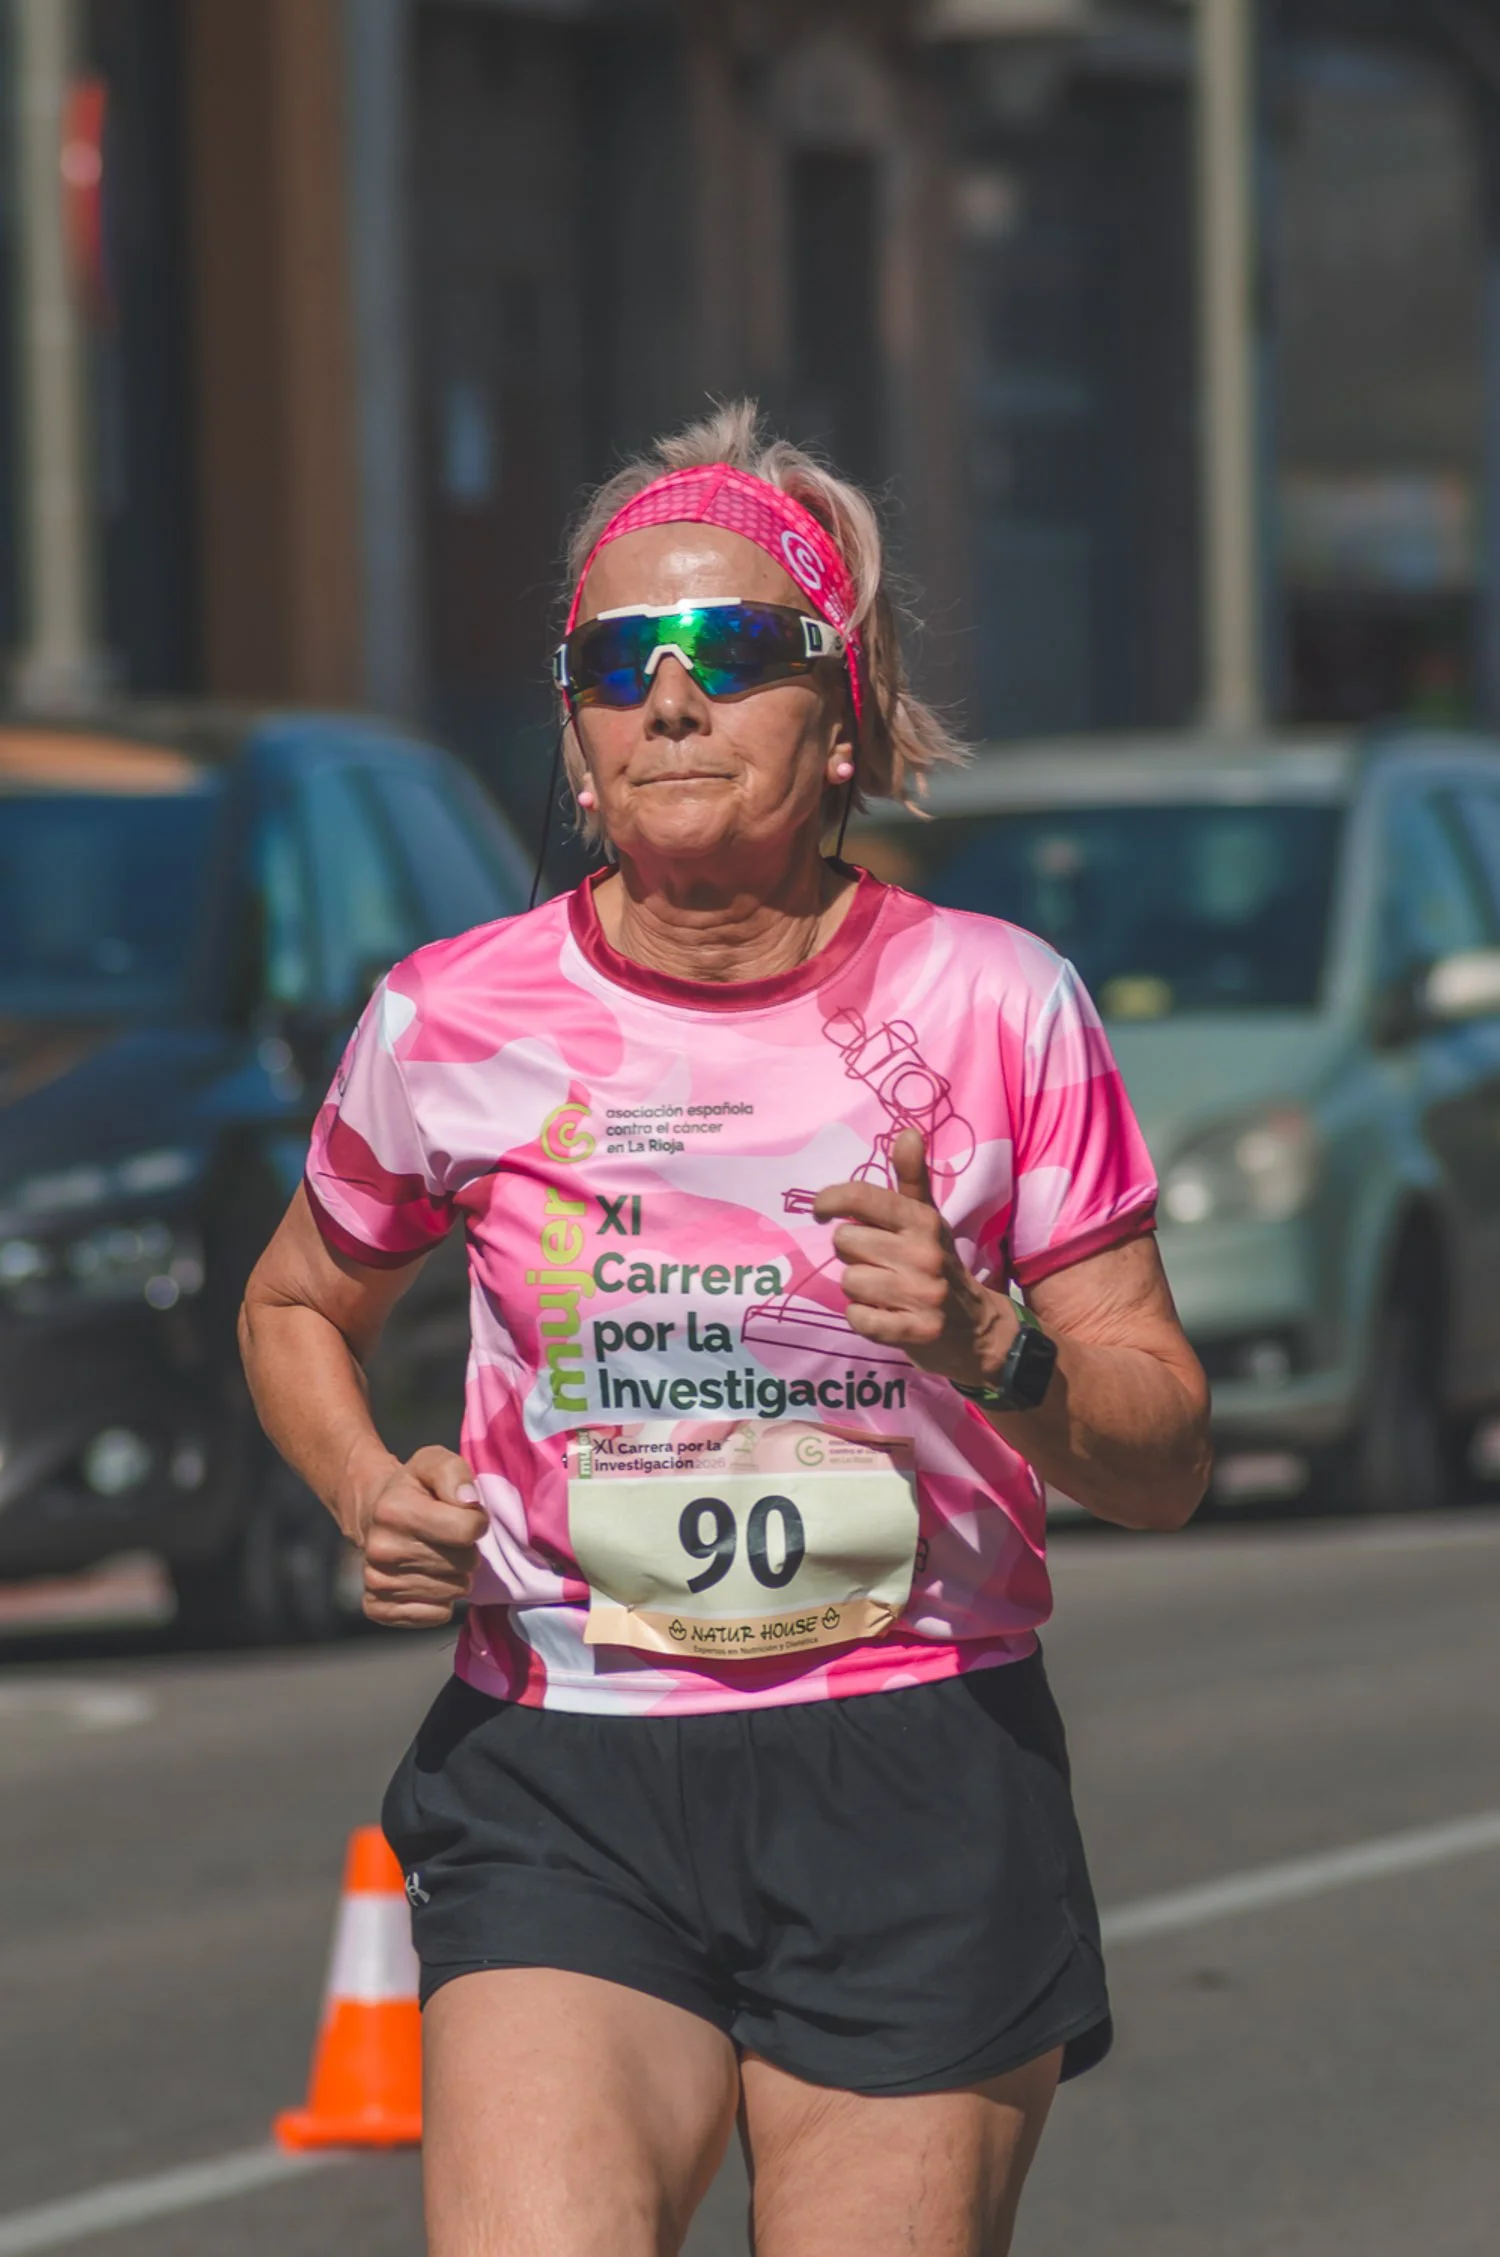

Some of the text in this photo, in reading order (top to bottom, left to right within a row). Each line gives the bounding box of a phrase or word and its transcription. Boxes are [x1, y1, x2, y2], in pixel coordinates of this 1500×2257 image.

[606, 1102, 754, 1119] asociación española
[606, 1121, 723, 1136] contra el cáncer
[607, 1138, 684, 1154] en La Rioja
[596, 1195, 641, 1236] XI
[593, 1251, 783, 1296] Carrera
[526, 1187, 597, 1412] mujer
[593, 1311, 733, 1362] por la
[598, 1368, 906, 1418] Investigación
[593, 1439, 721, 1454] XI Carrera por la
[595, 1457, 694, 1473] investigación
[678, 1495, 805, 1594] 90
[691, 1615, 818, 1643] NATUR HOUSE
